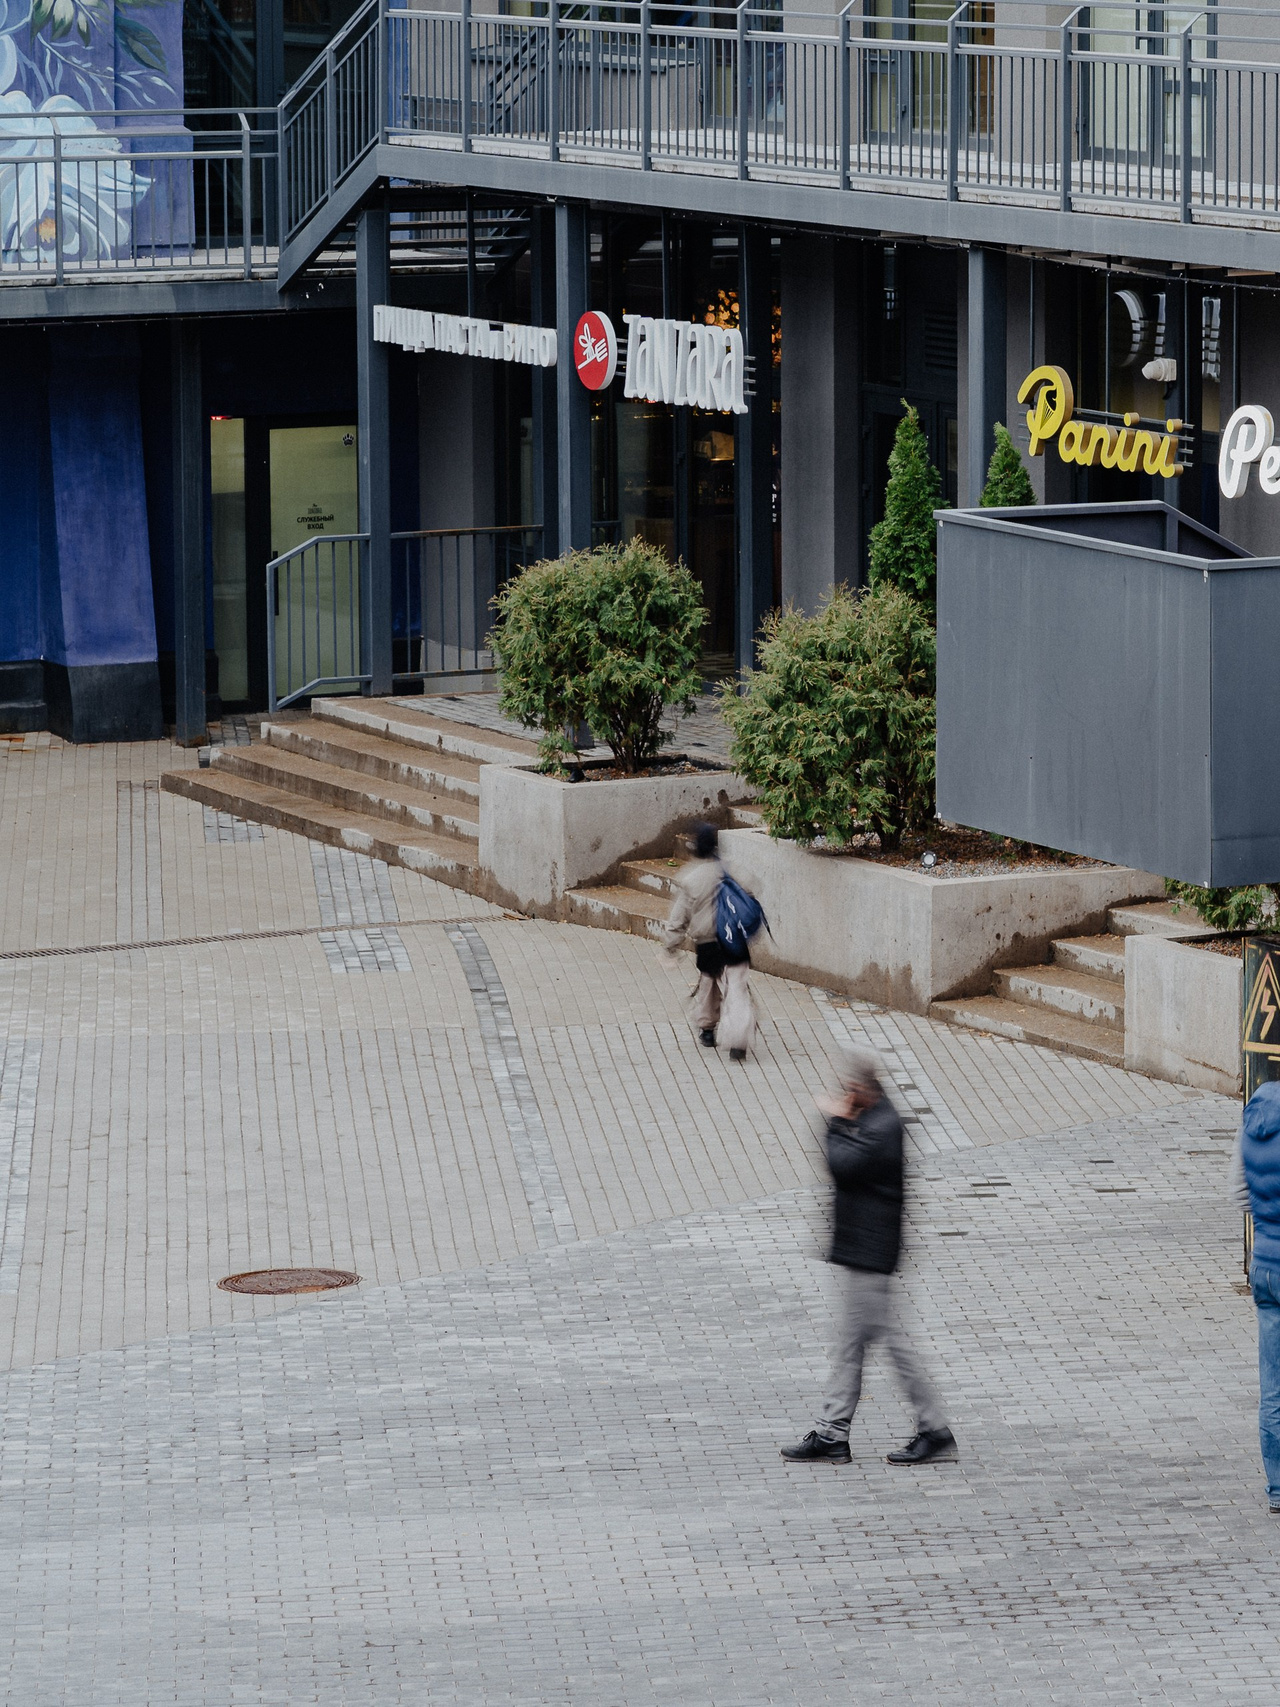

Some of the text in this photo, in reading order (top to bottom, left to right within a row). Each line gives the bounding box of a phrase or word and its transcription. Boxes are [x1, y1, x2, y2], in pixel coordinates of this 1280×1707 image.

[373, 304, 435, 353] ПИЦЦА
[434, 313, 490, 358] ПАСТА
[503, 323, 558, 368] ВИНО
[1017, 365, 1184, 479] Panini
[296, 514, 335, 523] СЛУЖЕБНЫЙ
